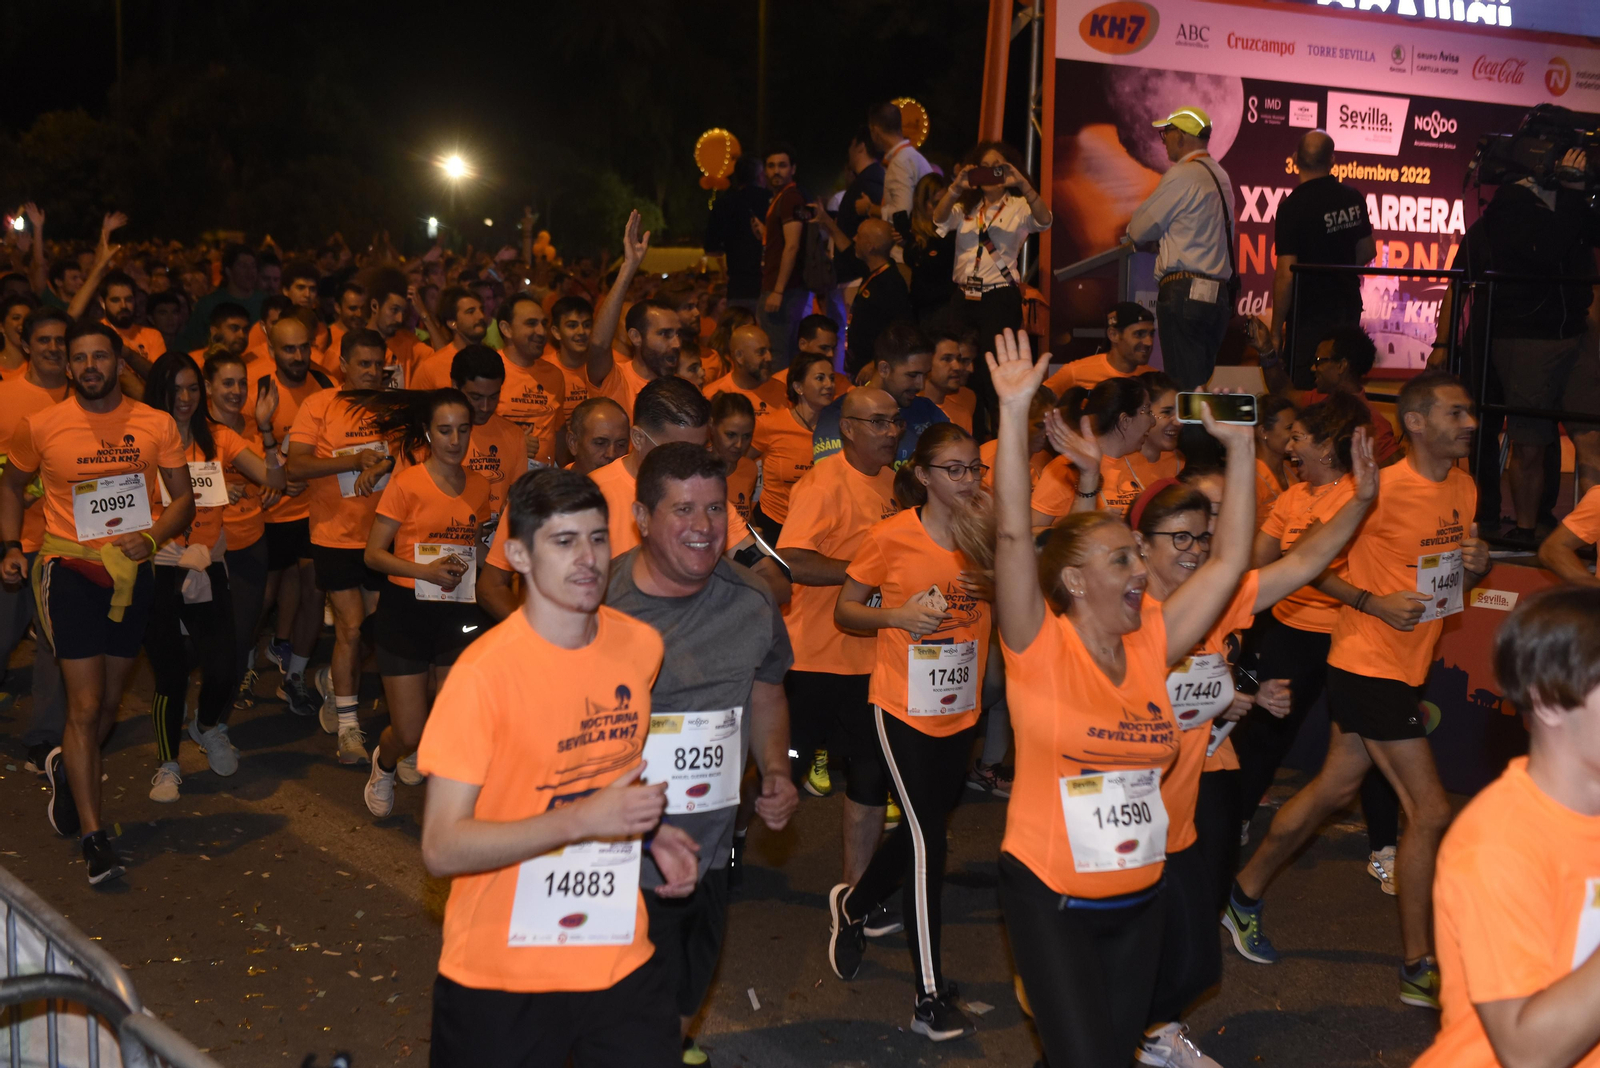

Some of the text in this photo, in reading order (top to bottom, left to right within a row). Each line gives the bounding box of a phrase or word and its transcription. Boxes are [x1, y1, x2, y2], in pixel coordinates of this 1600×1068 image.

[1176, 23, 1210, 42] ABC
[1227, 31, 1295, 57] Cruzcampo
[1307, 44, 1377, 63] TORRE SEVILLA
[1439, 51, 1460, 63] Avisa
[1264, 98, 1282, 111] IMD
[1331, 162, 1399, 183] eptiembre
[1400, 166, 1431, 184] 2022
[1239, 185, 1466, 235] XX ARRERA
[1324, 205, 1360, 228] STAFF
[1238, 291, 1269, 317] del
[77, 455, 117, 464] SEVILLA
[97, 448, 141, 456] NOCTURNA
[190, 477, 213, 488] 990
[90, 493, 136, 514] 20992
[428, 532, 460, 540] SEVILLA
[1420, 535, 1450, 547] SEVILLA
[1436, 525, 1464, 537] NOCTURNA
[1431, 571, 1460, 592] 14490
[929, 666, 969, 686] 17438
[1174, 681, 1222, 701] 17440
[580, 711, 638, 731] NOCTURNA
[1119, 721, 1173, 732] NOCTURNA
[557, 730, 605, 753] SEVILLA
[1086, 727, 1147, 743] SEVILLA
[674, 745, 724, 771] 8259
[1093, 801, 1152, 829] 14590
[545, 871, 615, 898] 14883
